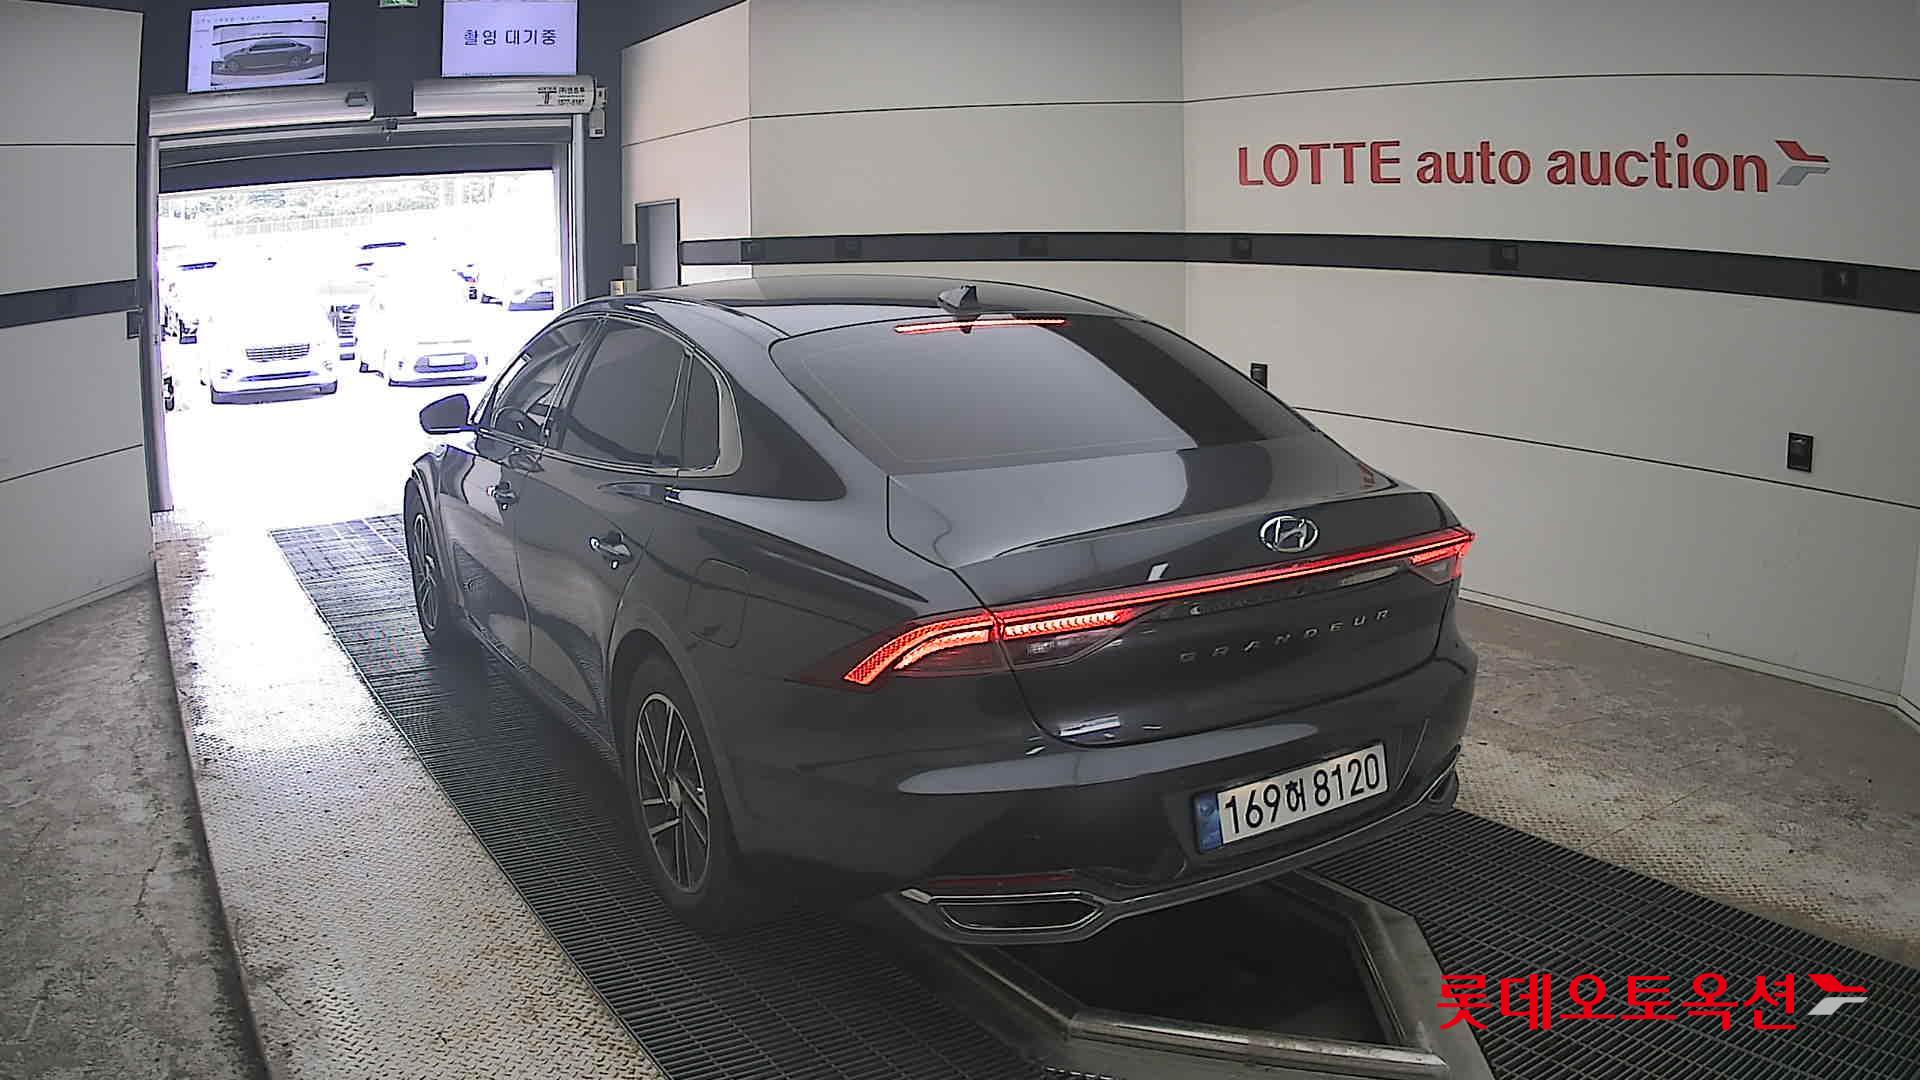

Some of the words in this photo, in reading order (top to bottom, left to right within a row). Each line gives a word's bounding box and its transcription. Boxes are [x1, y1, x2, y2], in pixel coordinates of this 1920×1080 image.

[505, 29, 557, 46] 대기중
[1238, 140, 1401, 187] LOTTE
[1416, 140, 1532, 186] auto
[1546, 133, 1769, 193] auction
[1178, 608, 1390, 665] GRANDEUR
[1313, 752, 1381, 807] 8120
